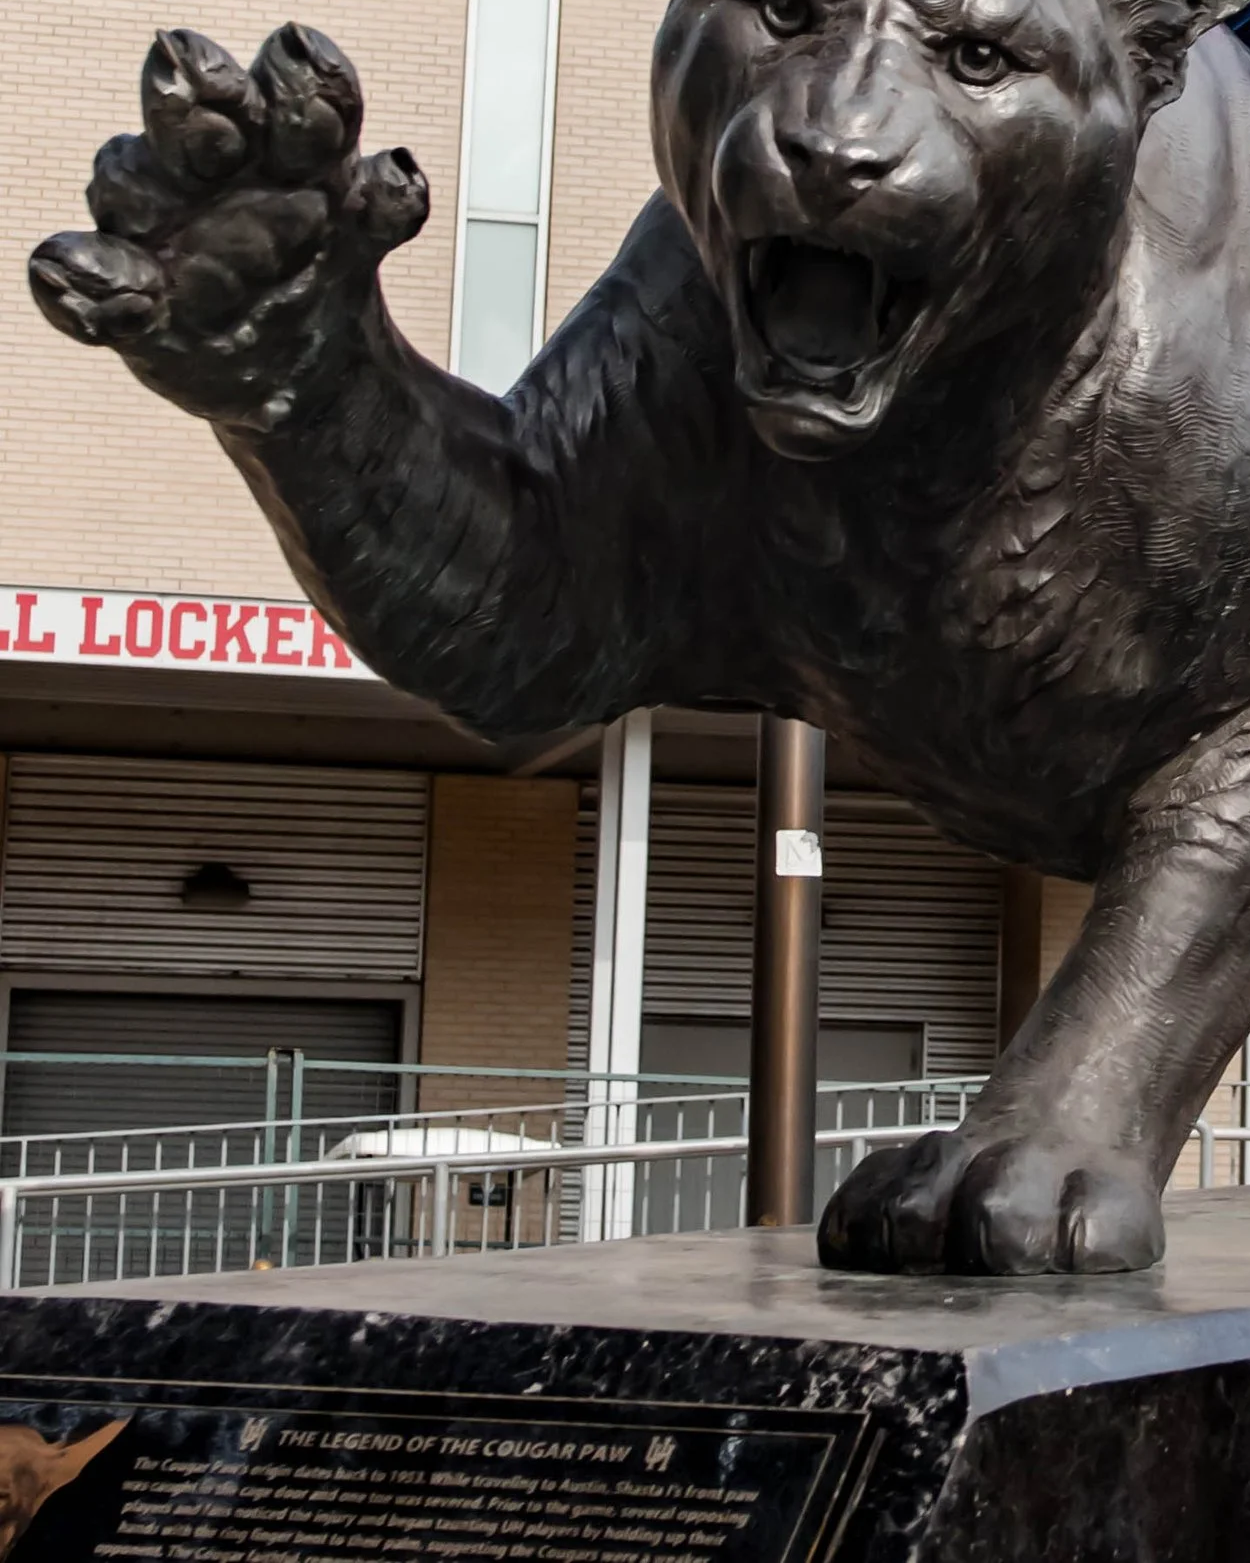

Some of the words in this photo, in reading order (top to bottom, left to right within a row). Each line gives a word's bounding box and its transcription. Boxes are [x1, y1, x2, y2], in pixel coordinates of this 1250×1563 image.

[278, 1430, 319, 1448] THE
[320, 1432, 403, 1452] LEGEND
[406, 1436, 439, 1453] OF
[439, 1437, 482, 1456] THE
[483, 1439, 577, 1460] COUGAR
[578, 1444, 632, 1463] PAW
